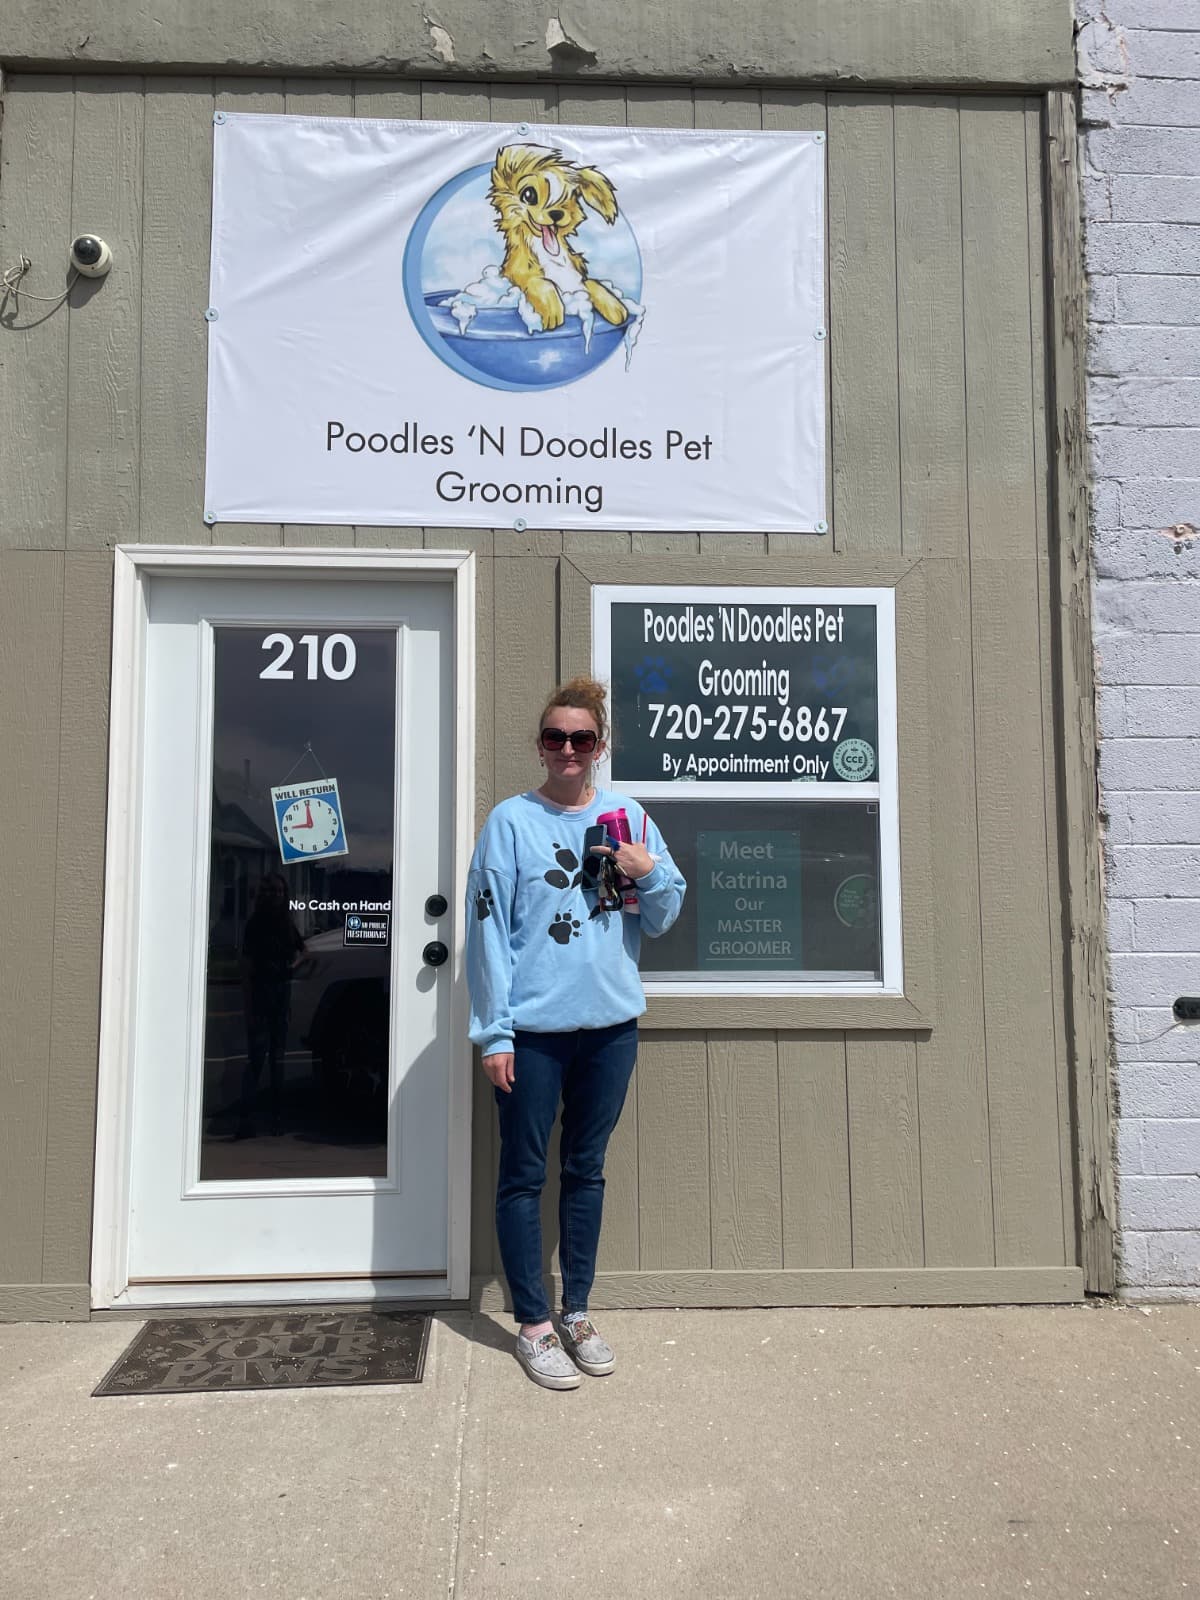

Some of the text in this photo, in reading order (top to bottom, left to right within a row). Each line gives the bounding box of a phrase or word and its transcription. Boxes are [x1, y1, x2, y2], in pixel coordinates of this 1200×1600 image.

[327, 421, 454, 456] Poodles
[520, 426, 652, 460] Doodles
[666, 429, 713, 461] Pet
[436, 470, 603, 513] Grooming
[643, 606, 714, 643] Poodles
[738, 607, 811, 643] Doodles
[815, 607, 844, 643] Pet
[259, 632, 357, 681] 210
[698, 659, 790, 706] Grooming
[648, 703, 848, 743] 720-275-6867
[662, 752, 830, 780] By Appointment Only
[845, 755, 863, 764] CCE
[275, 784, 336, 801] WILL RETURN
[719, 840, 774, 860] Meet
[711, 871, 788, 890] Katrina
[289, 899, 392, 911] No Cash on Hand
[734, 897, 764, 911] Our
[717, 919, 783, 933] MASTER
[709, 941, 791, 955] GROOMER
[169, 1334, 380, 1361] YOUR
[153, 1353, 368, 1389] PAWS
